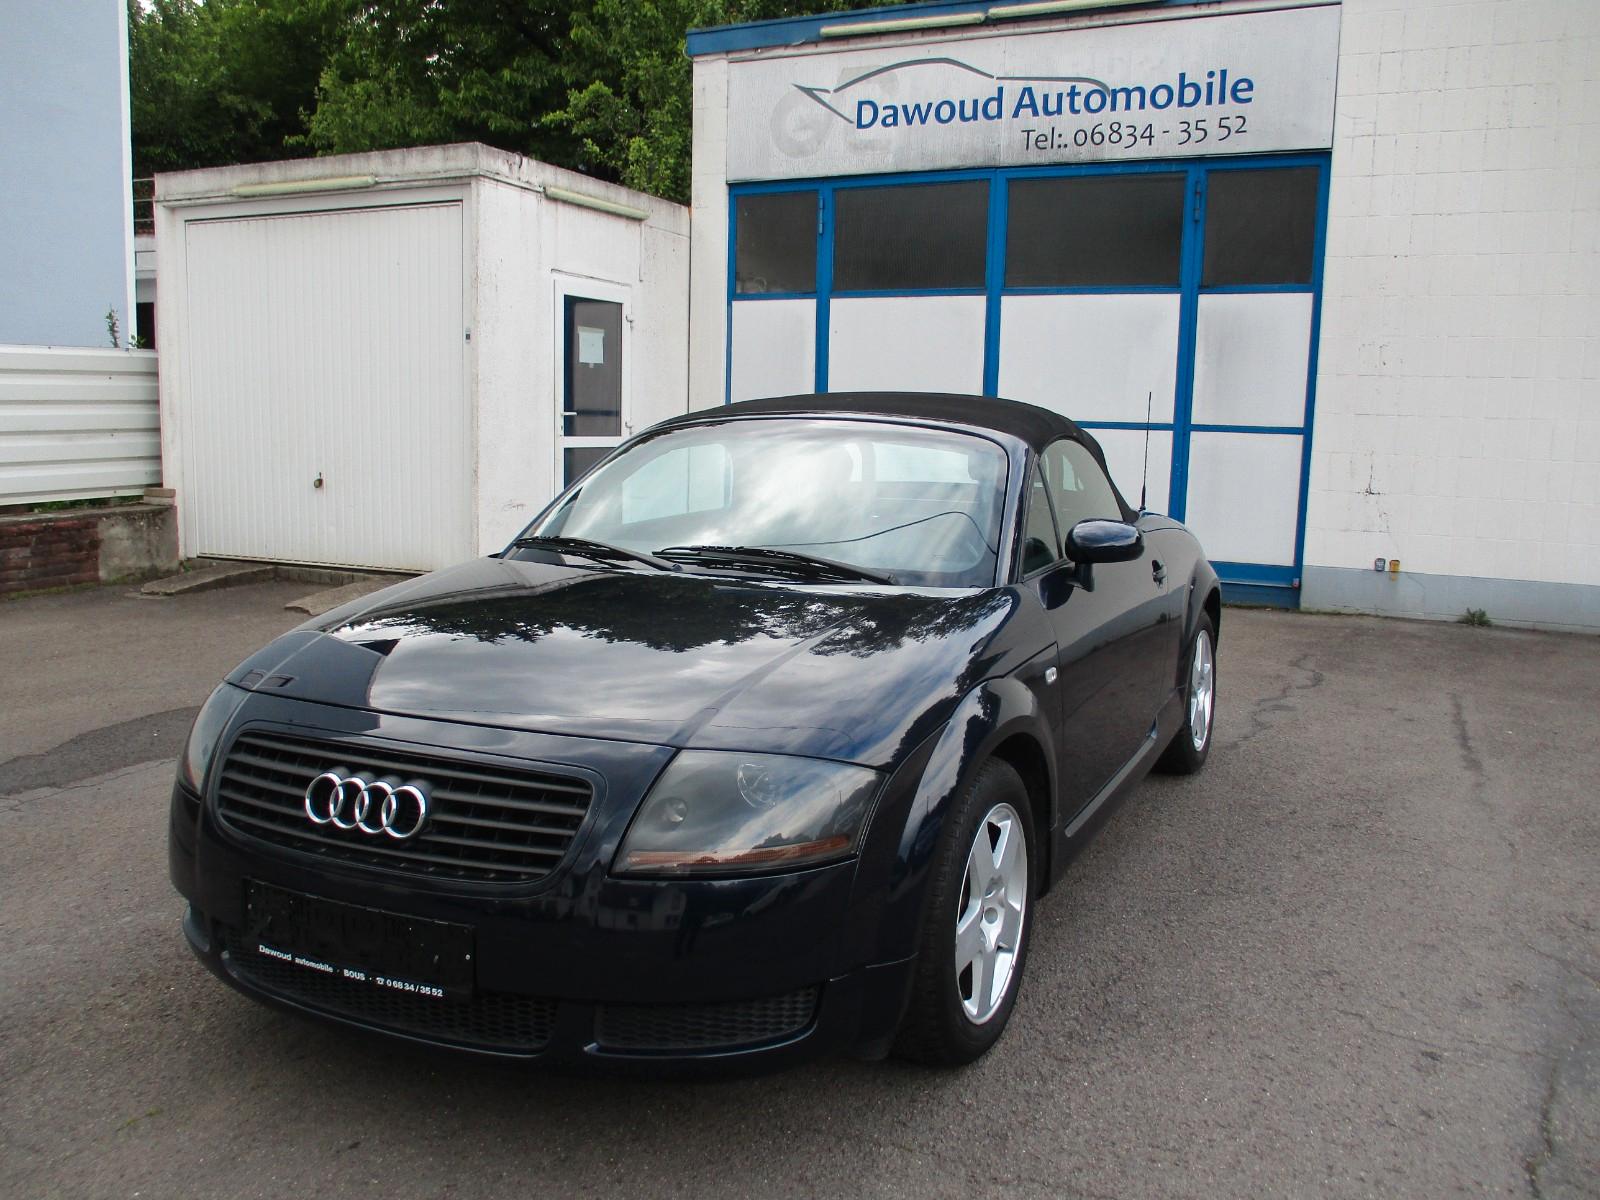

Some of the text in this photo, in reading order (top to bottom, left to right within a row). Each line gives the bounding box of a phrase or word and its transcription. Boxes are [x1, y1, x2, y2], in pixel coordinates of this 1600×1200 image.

[856, 68, 1254, 130] Dawoud Automobile
[259, 944, 292, 961] Dawoud
[343, 968, 366, 981] BOUS
